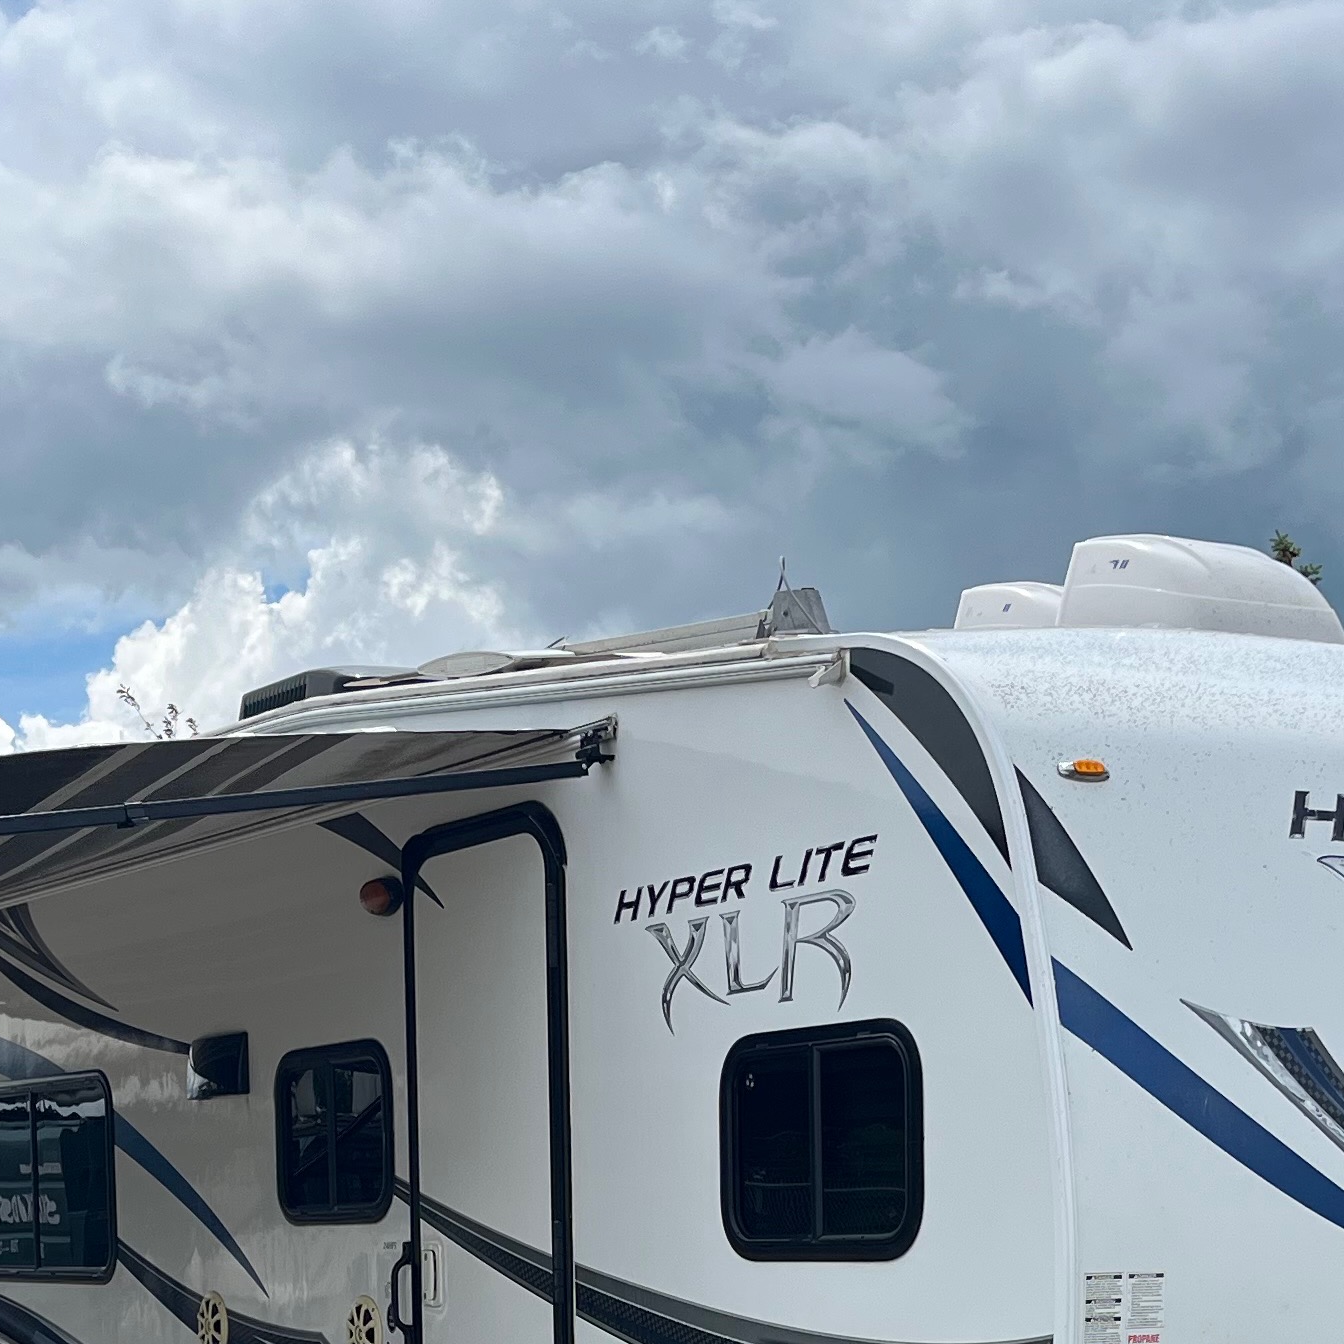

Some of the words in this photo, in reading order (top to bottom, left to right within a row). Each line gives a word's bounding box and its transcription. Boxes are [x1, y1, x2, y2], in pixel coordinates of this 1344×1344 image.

[613, 863, 753, 924] HYPER
[768, 834, 878, 893] LITE
[645, 888, 857, 1037] XLR
